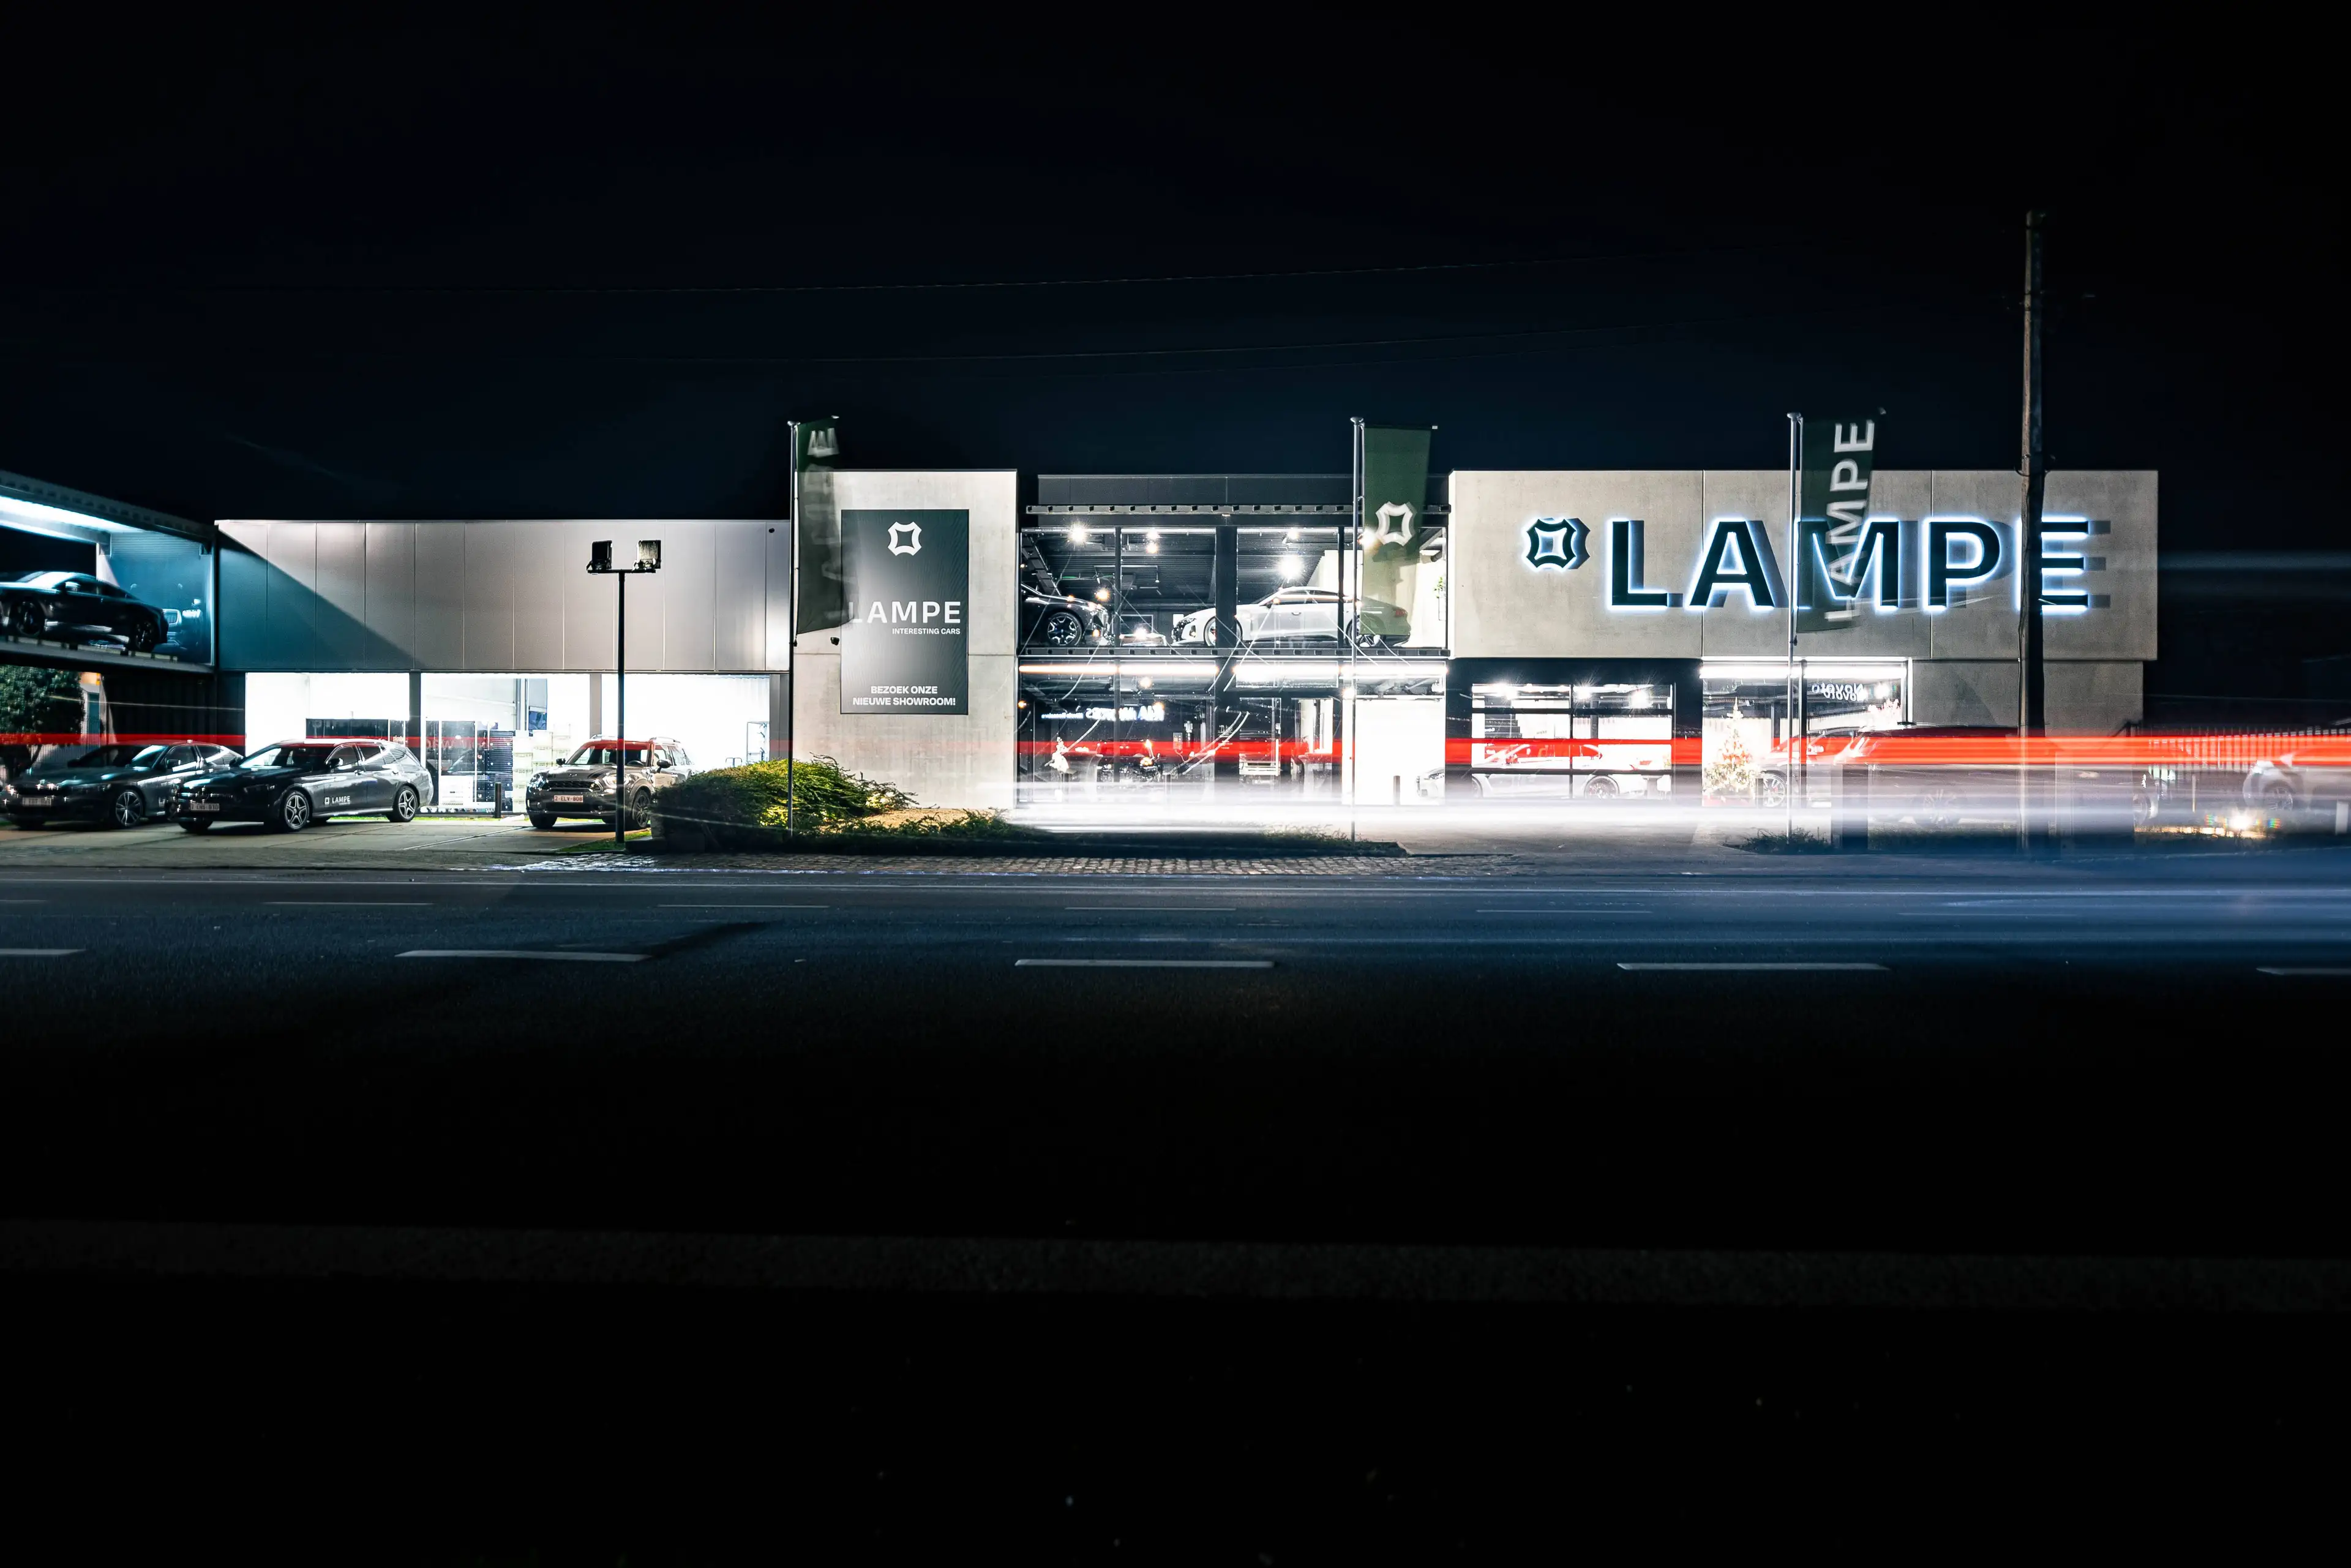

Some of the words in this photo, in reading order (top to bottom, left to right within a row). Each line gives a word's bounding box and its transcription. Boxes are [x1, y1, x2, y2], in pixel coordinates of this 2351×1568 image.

[1825, 420, 1874, 621] LAMPE
[1609, 517, 2089, 610] LAMPE
[849, 601, 961, 623] LAMPE
[871, 686, 909, 694] BEZOEK
[910, 686, 938, 694] ONZE
[852, 697, 891, 706] NIEUWE
[893, 697, 956, 706] SHOWROOM!
[332, 795, 351, 804] LAMPE
